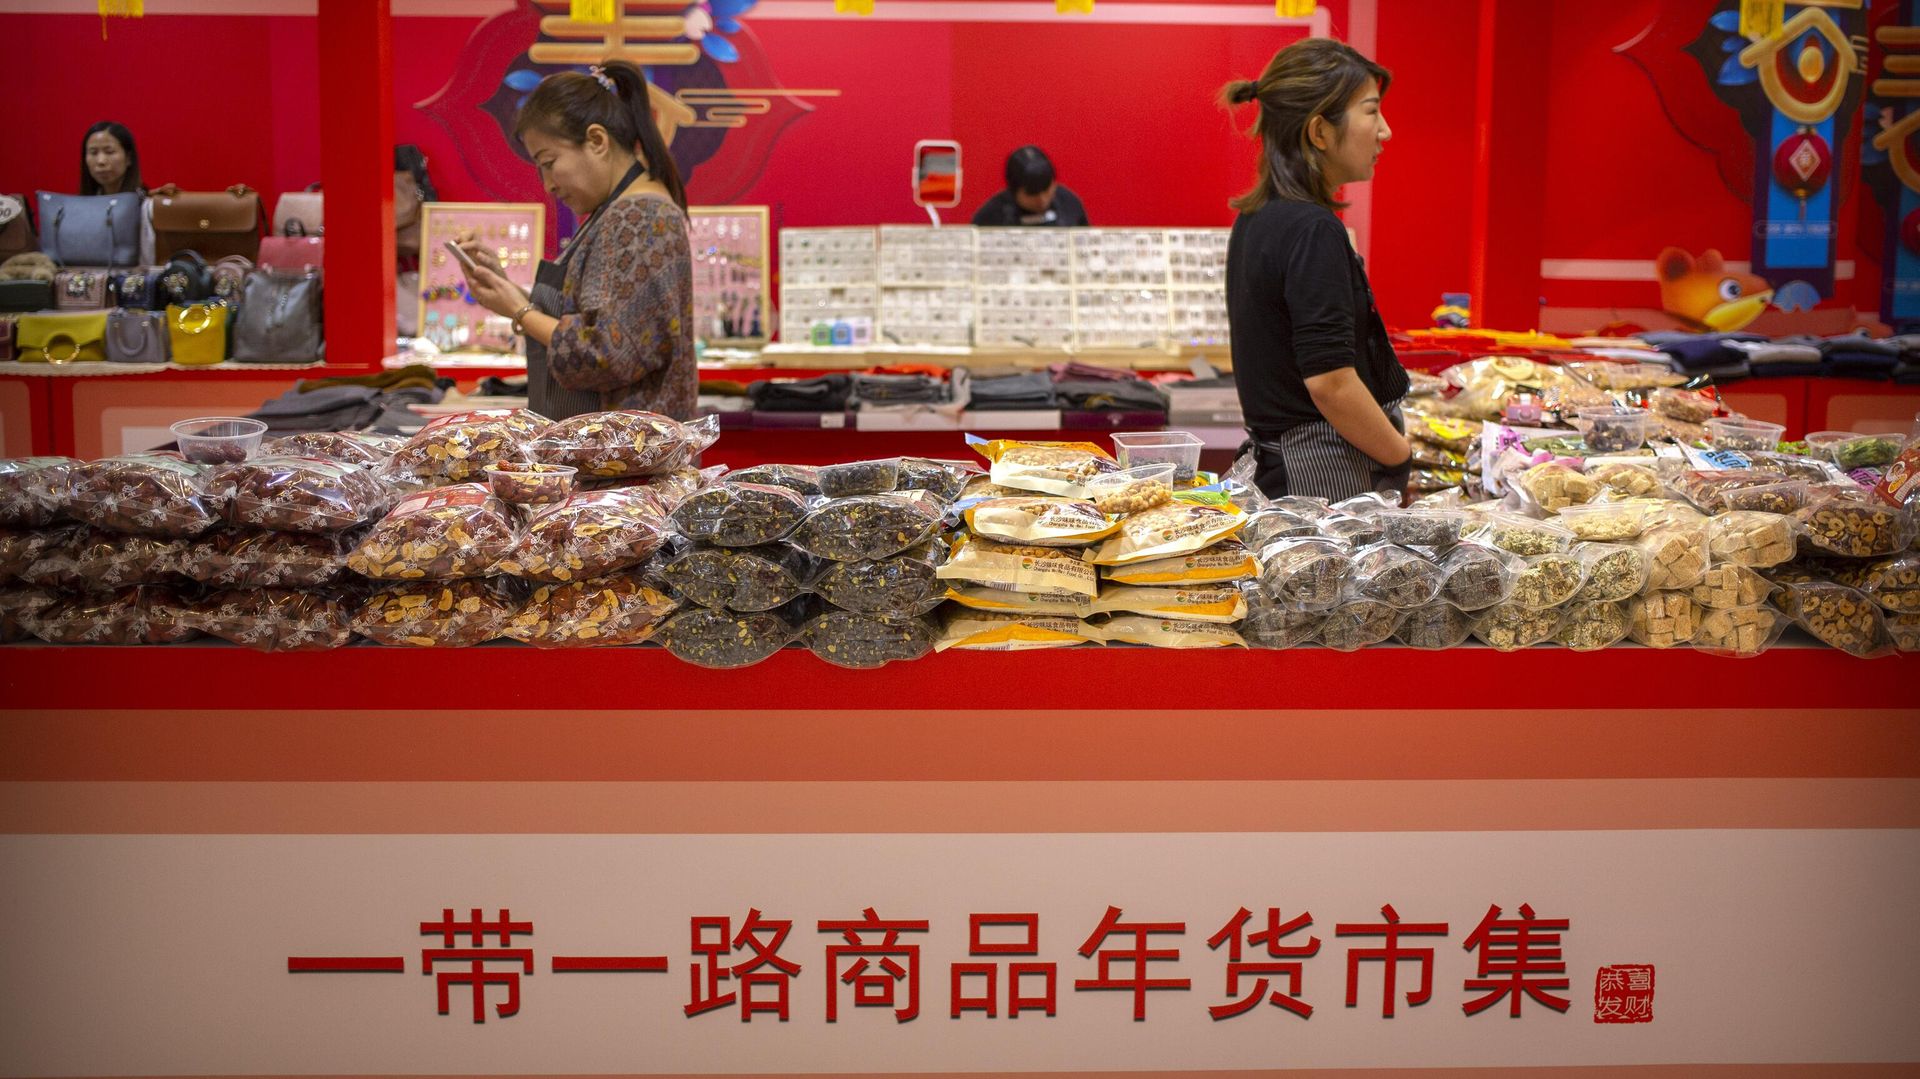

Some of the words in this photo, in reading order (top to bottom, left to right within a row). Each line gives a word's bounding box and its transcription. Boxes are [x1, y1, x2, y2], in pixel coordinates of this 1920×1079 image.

[287, 904, 1570, 1021] 一带一路商品年货市集
[1600, 970, 1650, 992] 恭喜
[1600, 995, 1650, 1016] 发财
